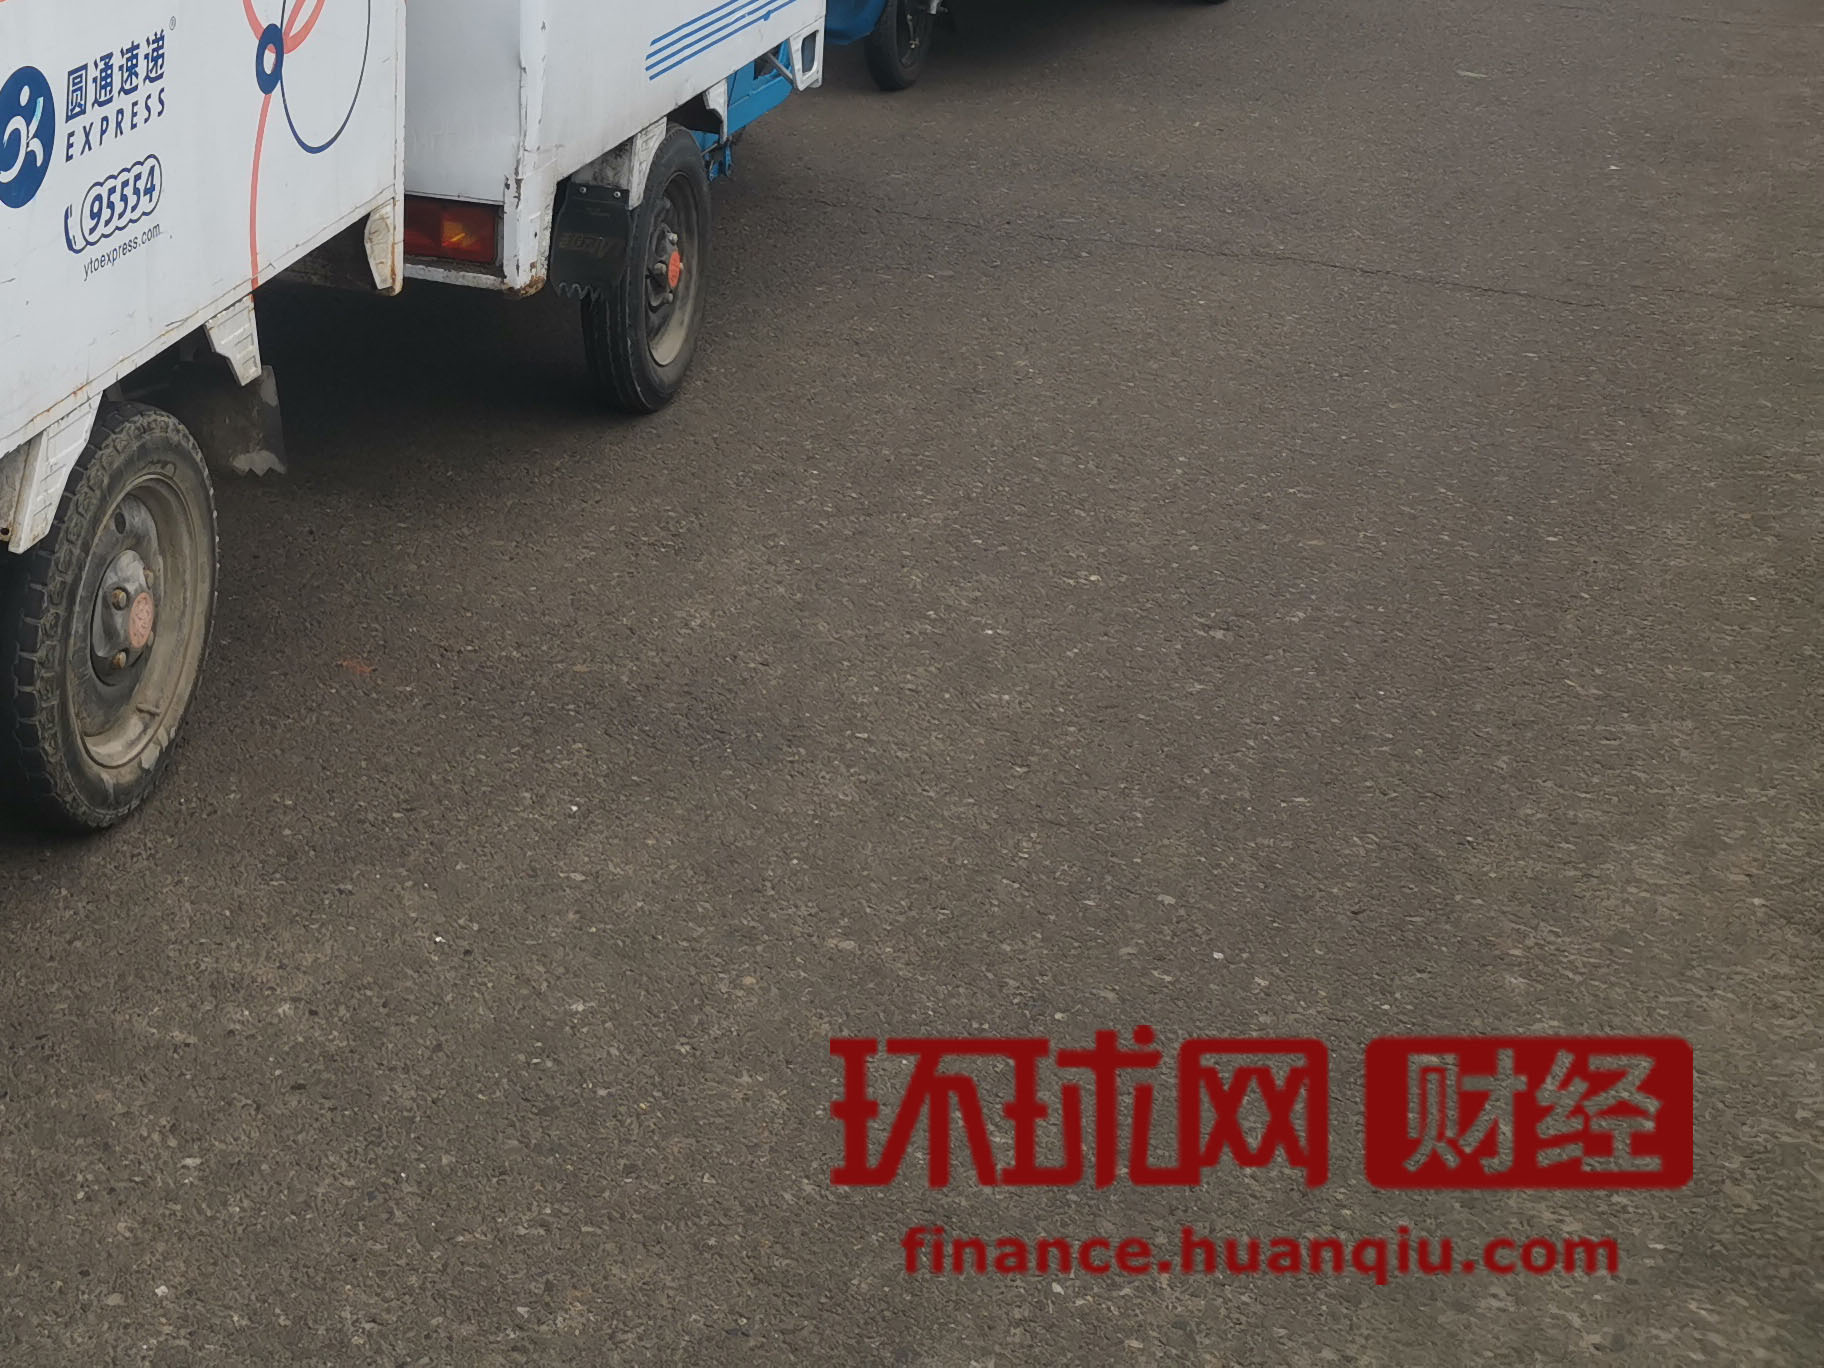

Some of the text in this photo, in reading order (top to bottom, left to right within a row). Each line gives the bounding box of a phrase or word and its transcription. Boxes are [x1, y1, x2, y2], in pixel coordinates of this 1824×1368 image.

[64, 28, 166, 124] 圆通速递
[65, 86, 165, 163] EXPRESS
[88, 163, 157, 237] 95554
[83, 223, 161, 282] ytoexpress.com
